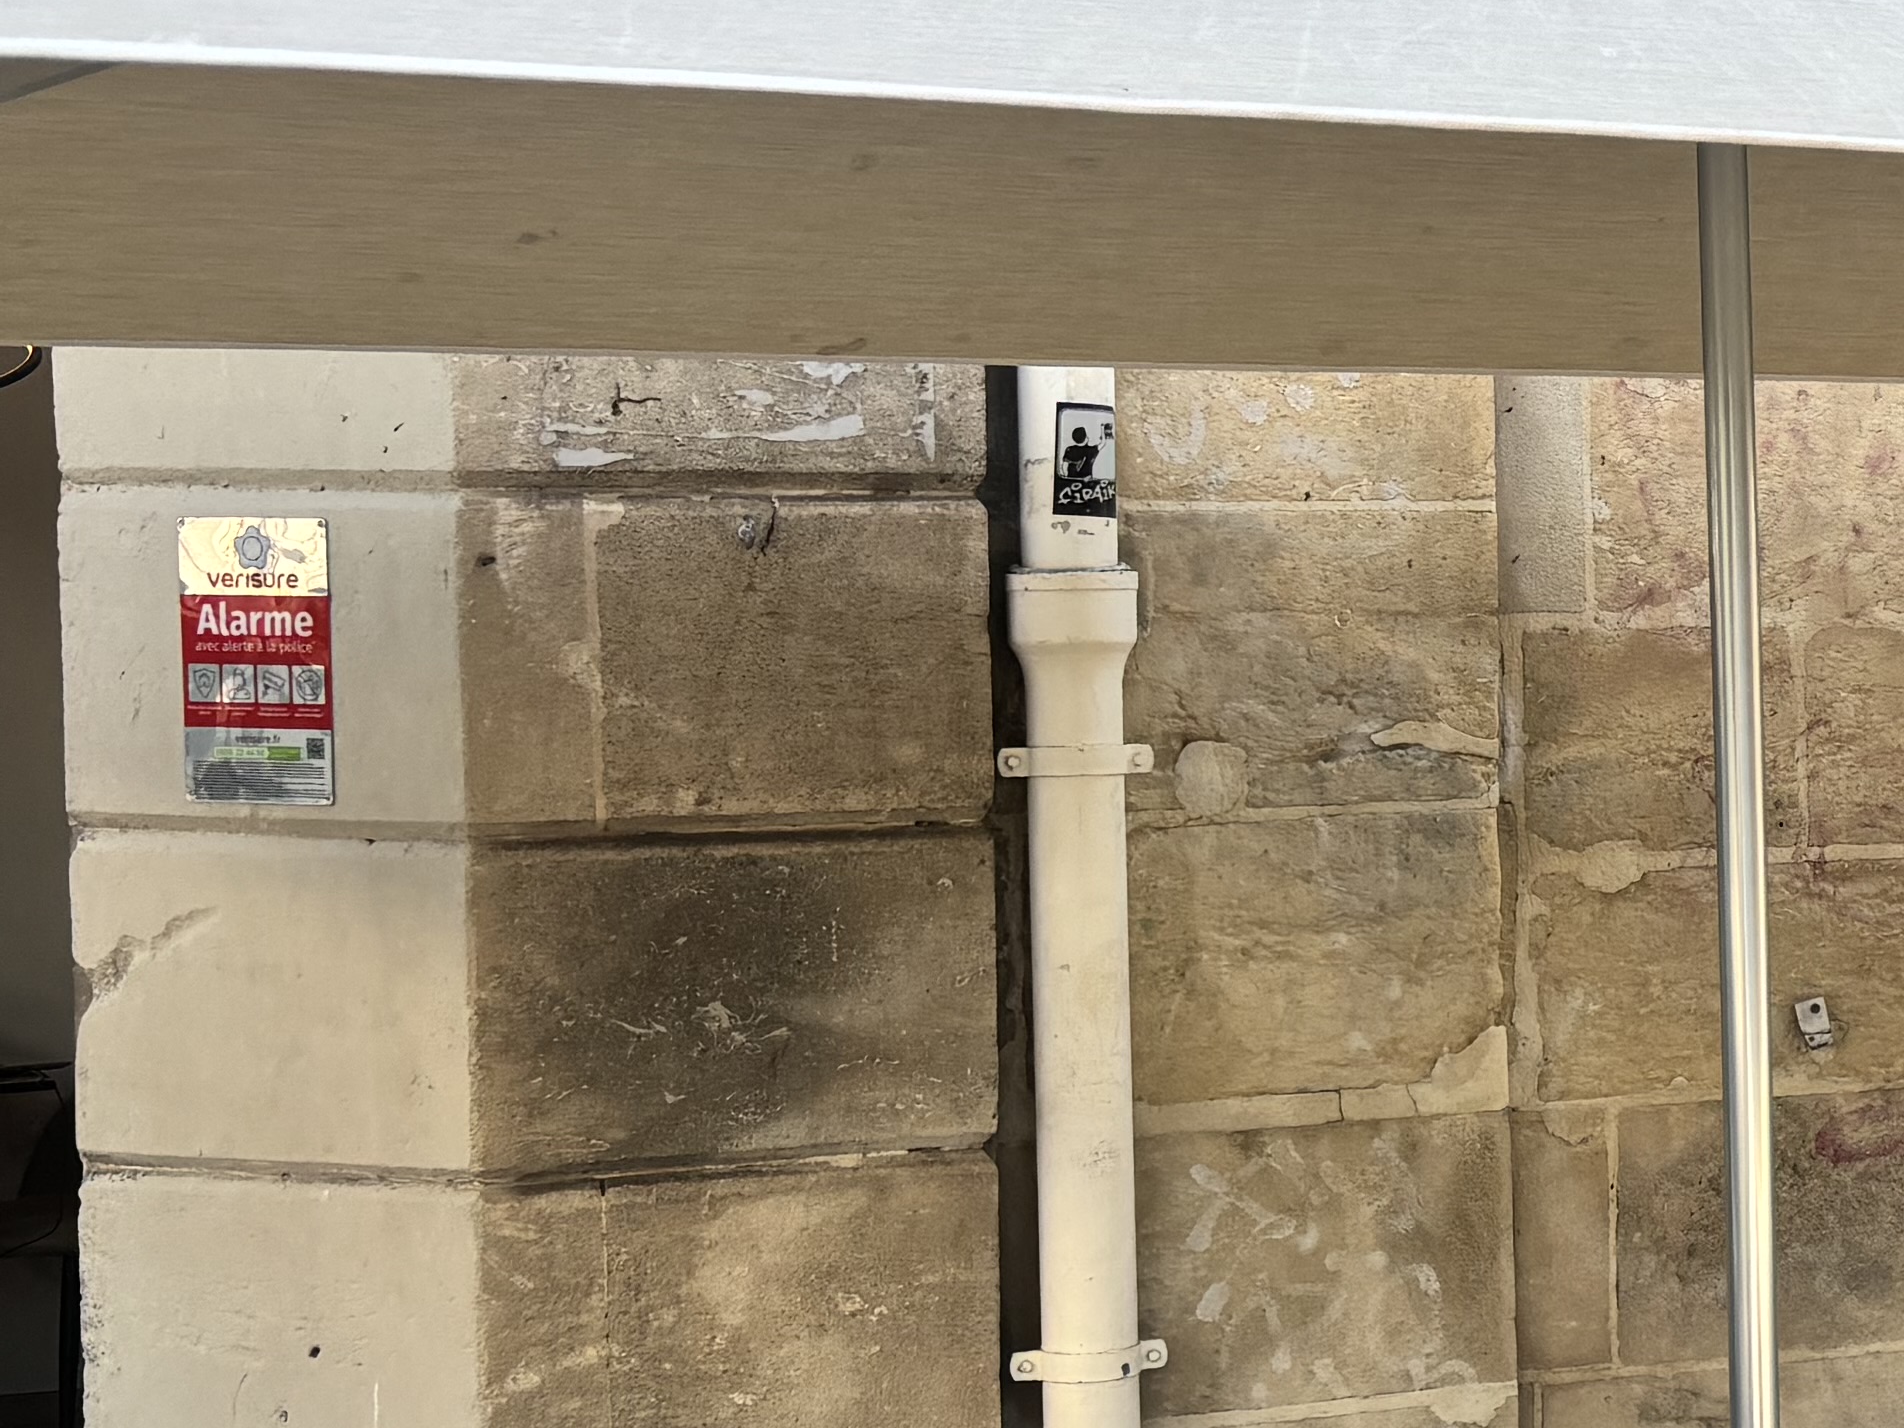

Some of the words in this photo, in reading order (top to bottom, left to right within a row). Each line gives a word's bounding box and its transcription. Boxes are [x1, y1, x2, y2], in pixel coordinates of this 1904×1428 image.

[207, 572, 299, 589] verisure
[196, 600, 314, 637] Alarme
[195, 641, 220, 652] avec
[221, 639, 255, 652] alerte
